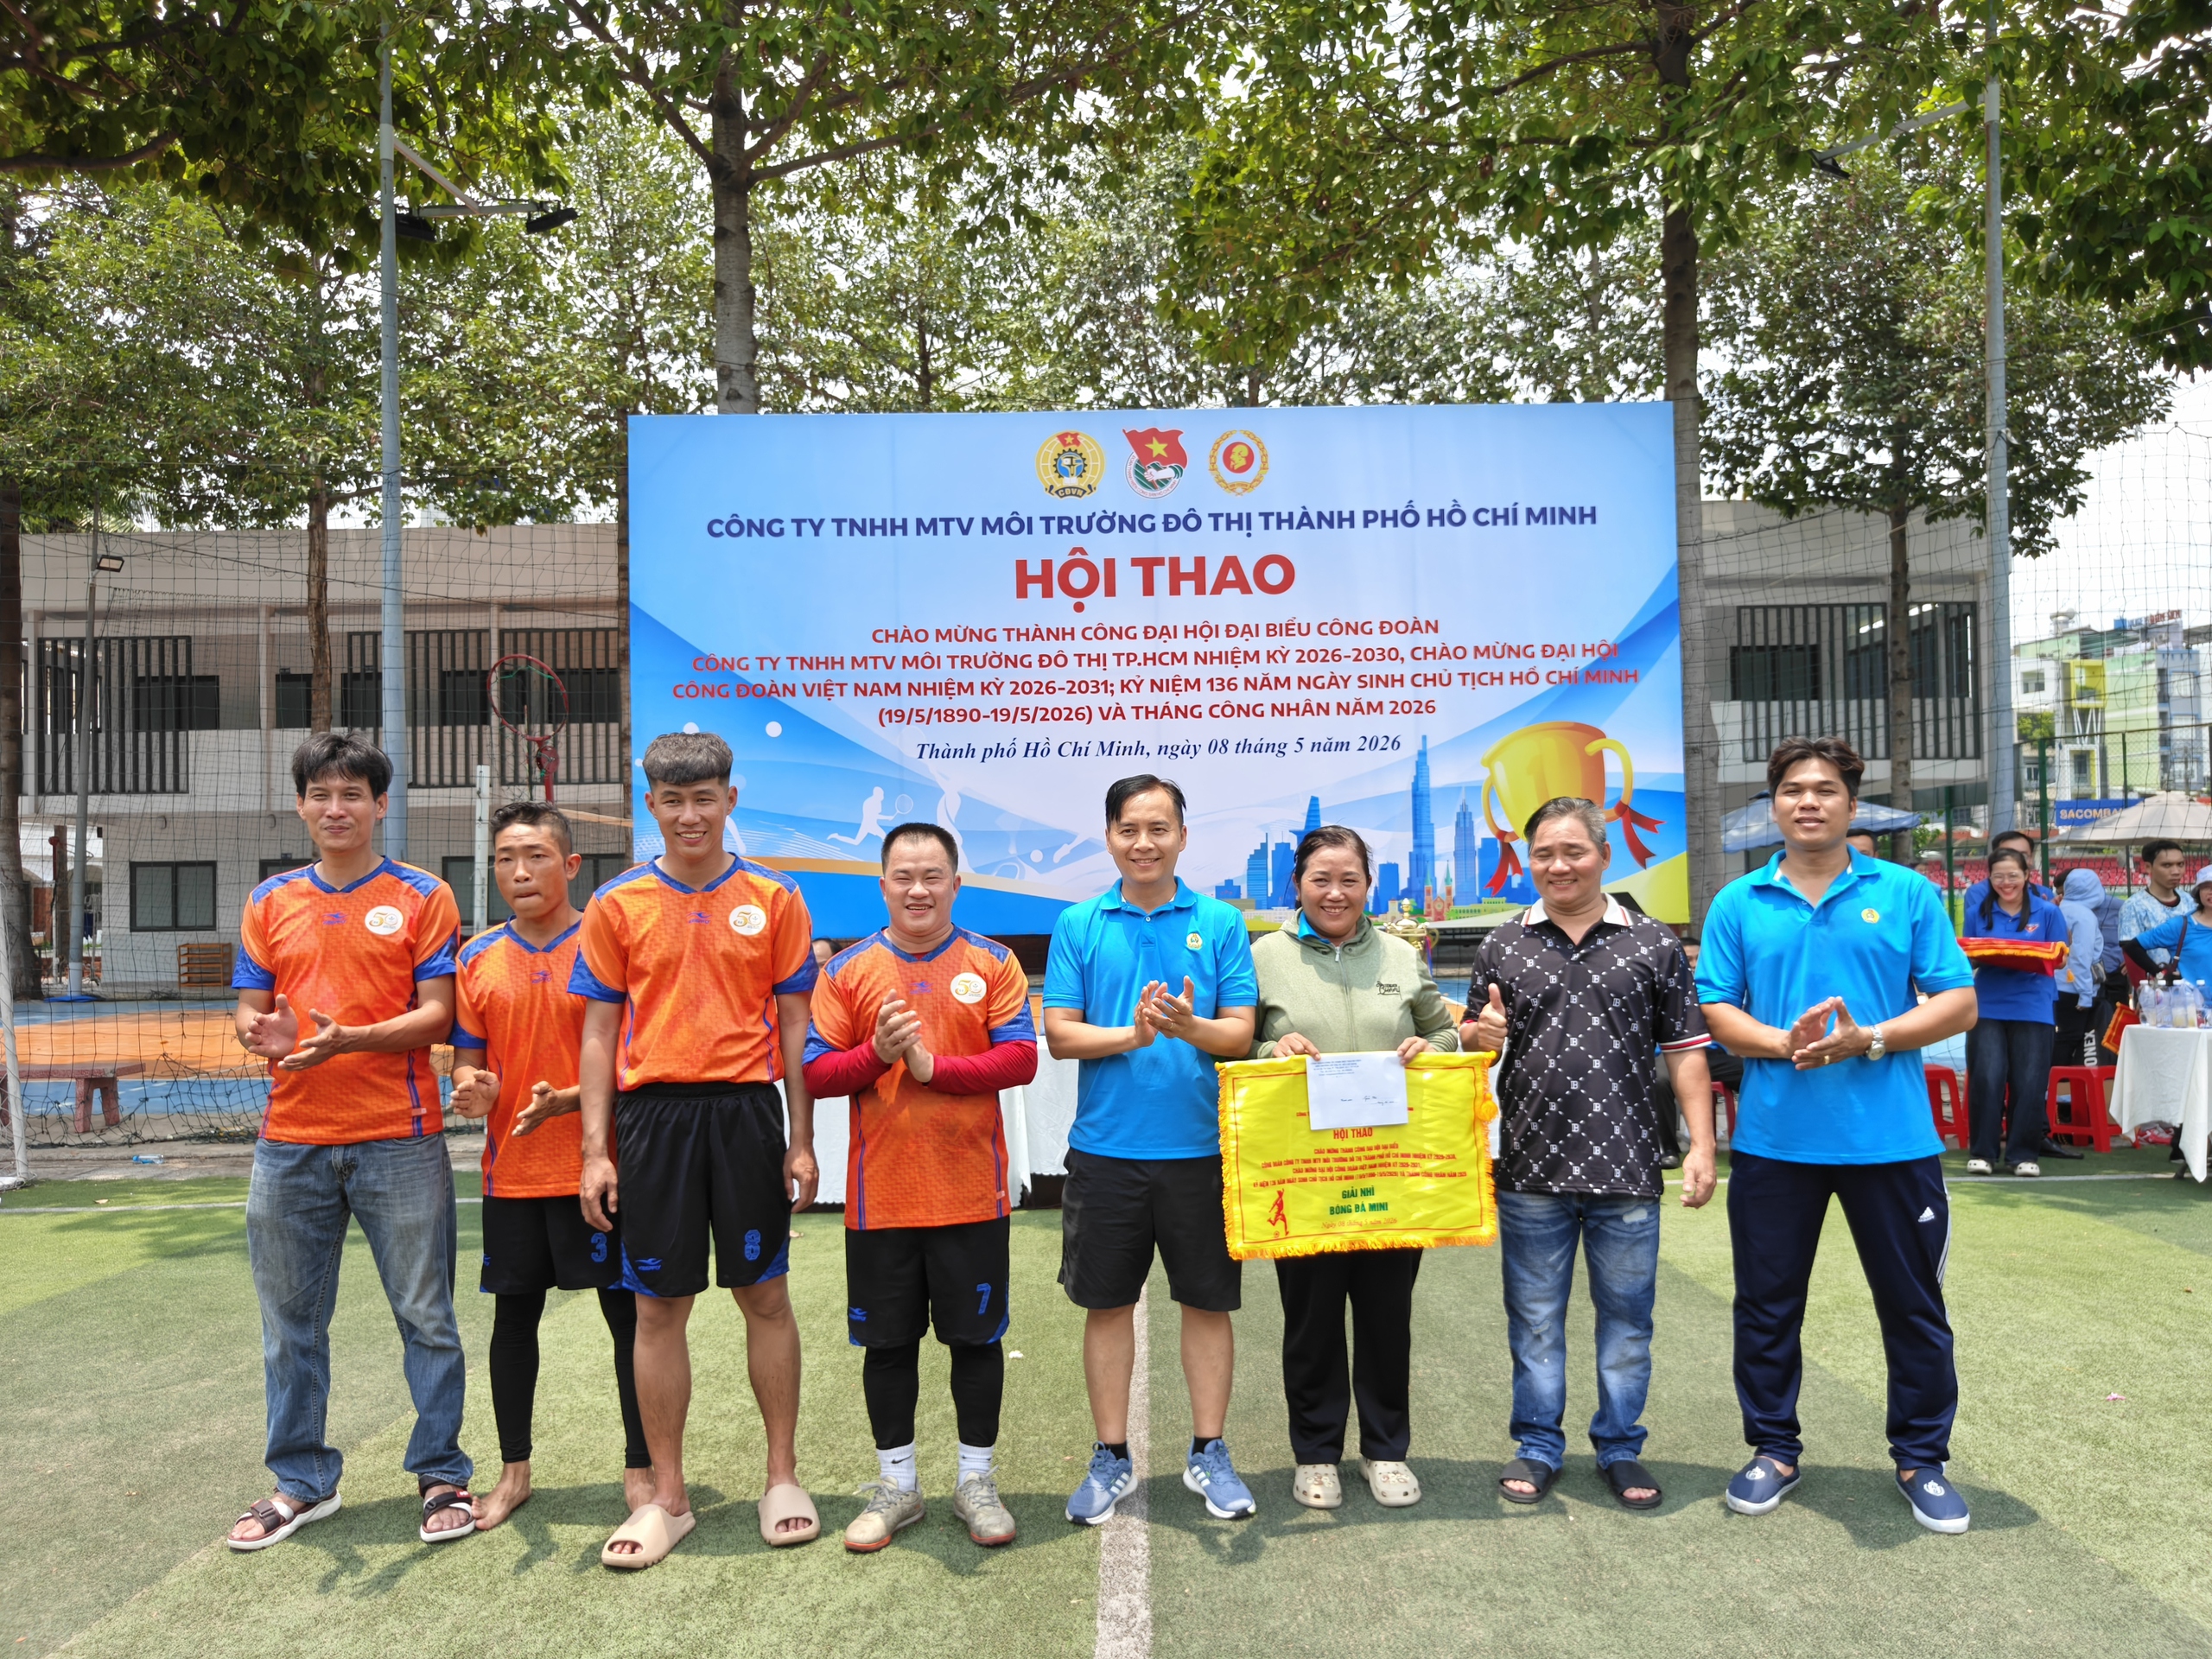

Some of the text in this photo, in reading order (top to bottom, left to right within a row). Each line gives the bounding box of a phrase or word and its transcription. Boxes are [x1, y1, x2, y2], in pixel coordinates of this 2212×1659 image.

[708, 500, 1596, 537] CÔNG TY TNHH MTV MÔI TRƯỜNG ĐÔ THỊ THÀNH PHỐ HỒ CHÍ MINH
[1016, 546, 1295, 613] HỘI THAO
[873, 615, 1438, 643] CHÀO MỪNG THÀNH CÔNG ĐẠI HỘI ĐẠI BIỂU CÔNG ĐOÀN
[693, 639, 1617, 671] CÔNG TY TNHH MTV MÔI TRƯỜNG ĐÔ THỊ TP.HCM NHIỆM KỲ 2026-2030, CHÀO MỪNG ĐẠI HỘI
[674, 663, 1637, 701] CÔNG ĐOÀN VIỆT NAM NHIỆM KỲ 2026-2031; KỶ NIỆM 136 NĂM NGÀY SINH CHỦ TỊCH HỒ CHÍ MINH
[879, 698, 1436, 728] (19/5/1890-19/5/2026) VÀ THÁNG CÔNG NHÂN NĂM 2026
[917, 735, 1401, 763] Thành phố Hồ Chí Minh, ngày 08 tháng 5 năm 2026
[2060, 808, 2122, 820] SACOMBA
[1333, 1128, 1373, 1141] HỘI THAO
[1330, 1205, 1352, 1216] BÓNG
[1369, 1202, 1388, 1211] MINI
[590, 1232, 607, 1262] 3
[744, 1229, 761, 1262] 8
[976, 1282, 992, 1315] 7
